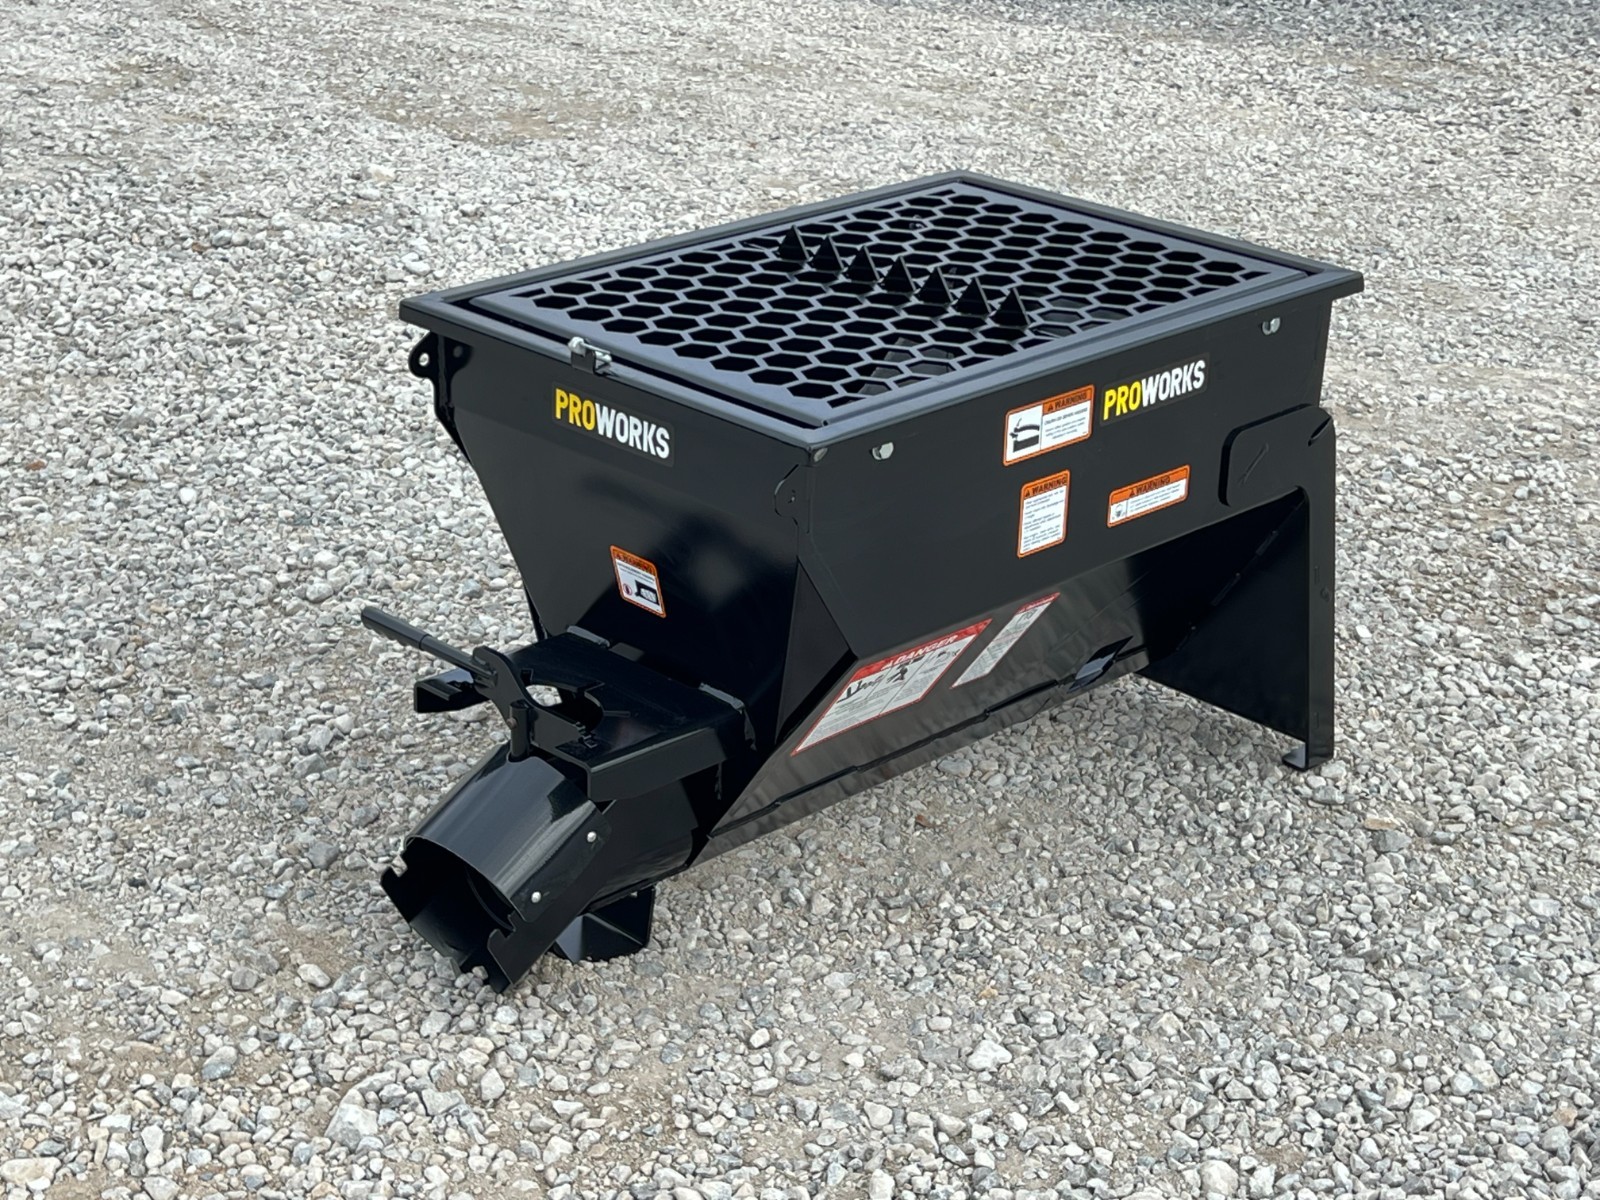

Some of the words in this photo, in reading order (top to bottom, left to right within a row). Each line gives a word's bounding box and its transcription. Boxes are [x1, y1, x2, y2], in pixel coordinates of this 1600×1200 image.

[1103, 360, 1205, 420] PROWORKS
[556, 388, 670, 459] PROWORKS
[1033, 476, 1068, 495] WARNING
[894, 635, 958, 664] DANGER
